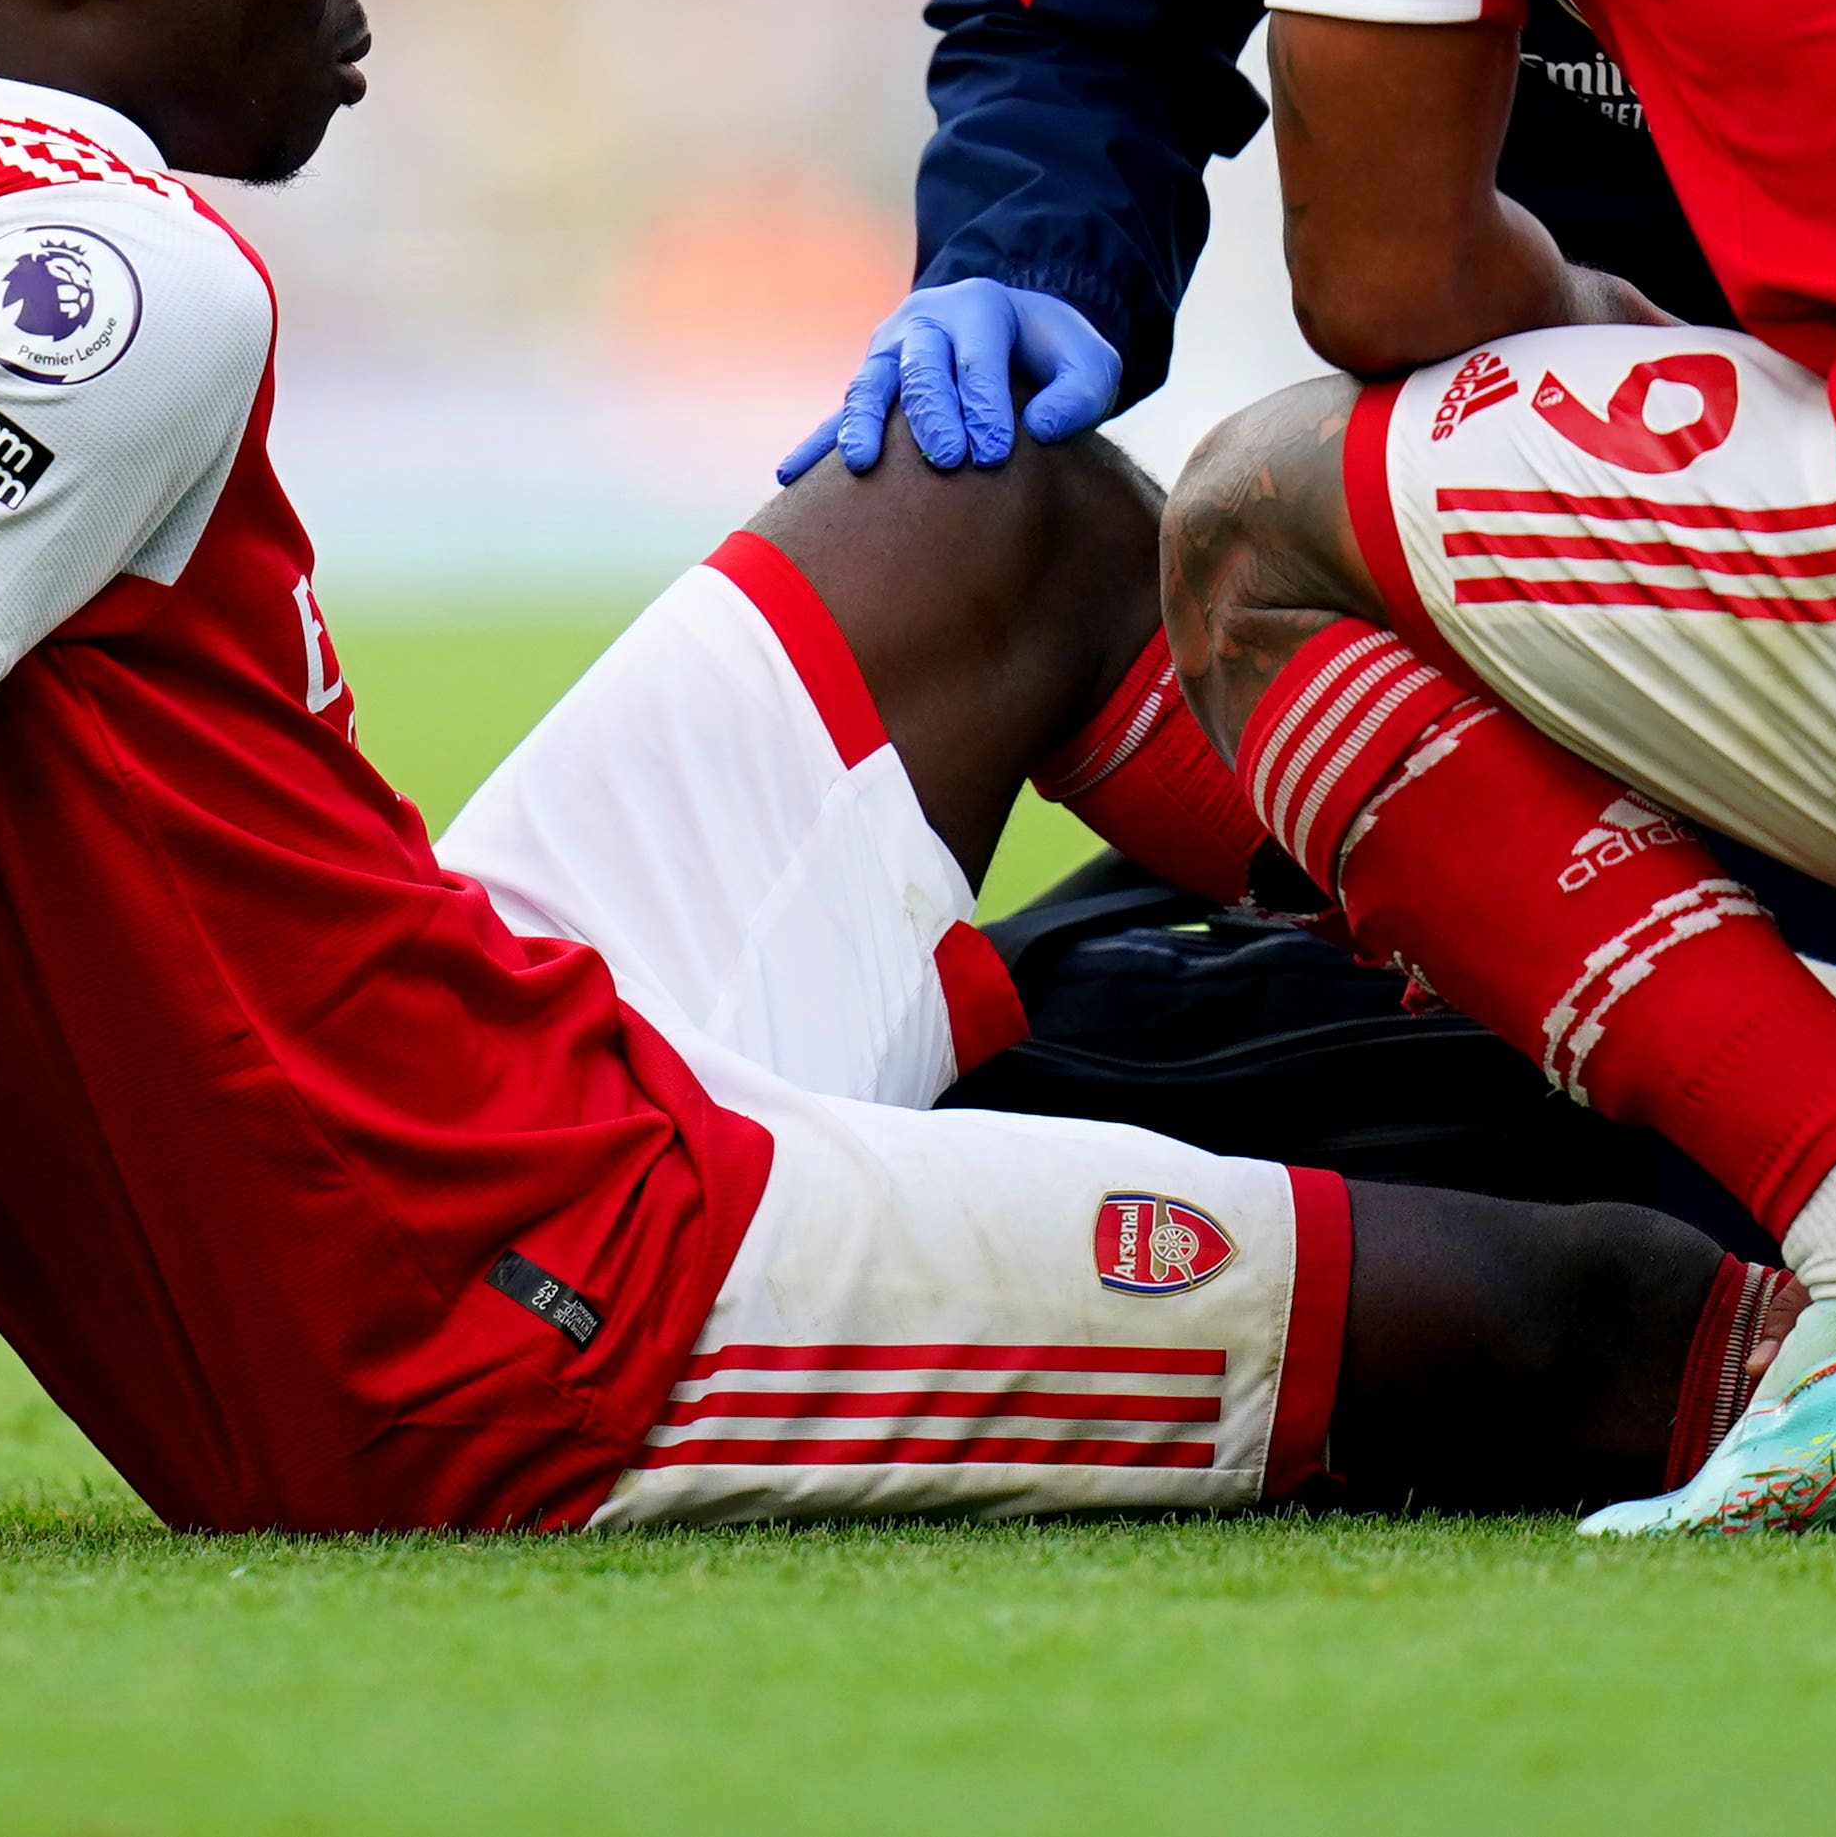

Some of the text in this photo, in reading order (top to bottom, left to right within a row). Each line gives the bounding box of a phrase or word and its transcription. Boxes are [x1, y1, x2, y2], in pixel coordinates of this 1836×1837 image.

[18, 316, 118, 366] Premier League
[1431, 351, 1491, 442] adidas
[1112, 1205, 1141, 1281] Arsenal
